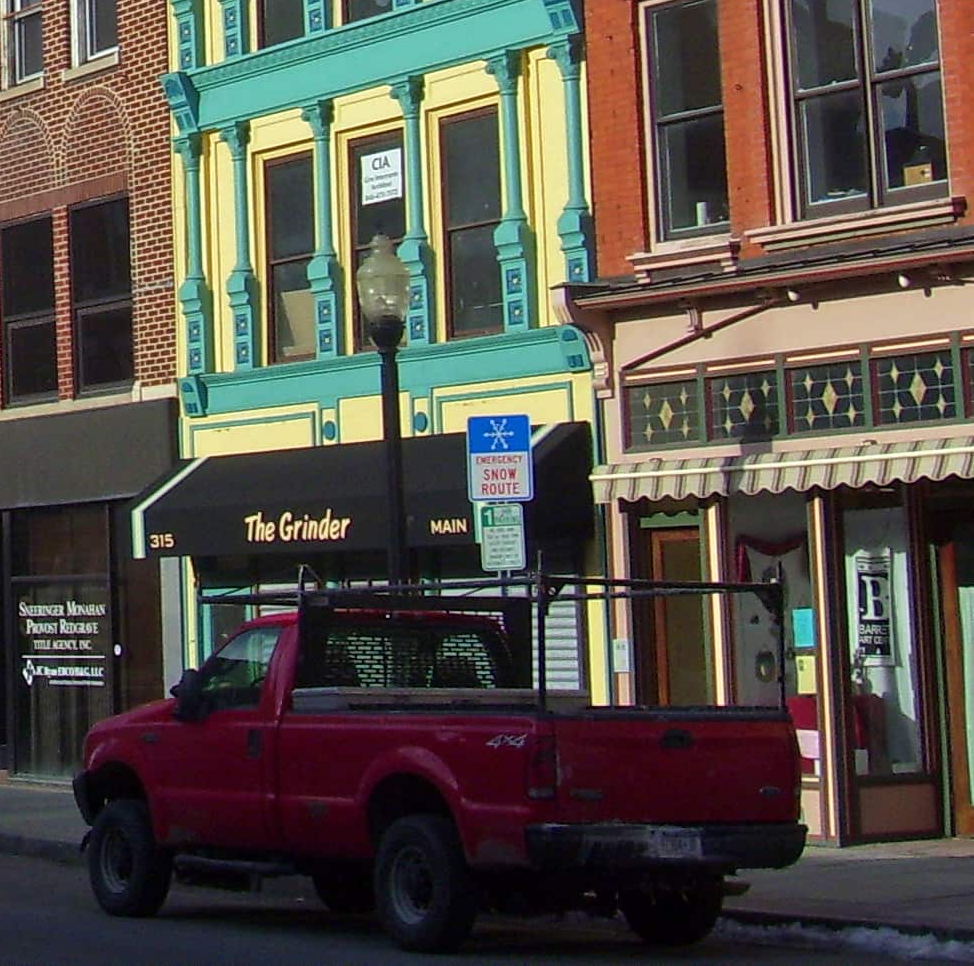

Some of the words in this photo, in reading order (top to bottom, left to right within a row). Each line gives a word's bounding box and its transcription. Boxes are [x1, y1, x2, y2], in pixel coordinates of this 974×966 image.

[371, 155, 391, 171] CIA
[475, 455, 523, 465] EMERGENCY
[483, 468, 517, 481] SNOW
[481, 482, 521, 495] ROUTE
[483, 508, 493, 526] 1
[149, 534, 175, 549] 315
[244, 511, 275, 542] The
[279, 508, 351, 542] Grinder
[430, 518, 468, 535] MAIN
[67, 600, 106, 617] MONAHAN
[26, 619, 58, 635] PROVOST
[33, 639, 51, 650] TITLE
